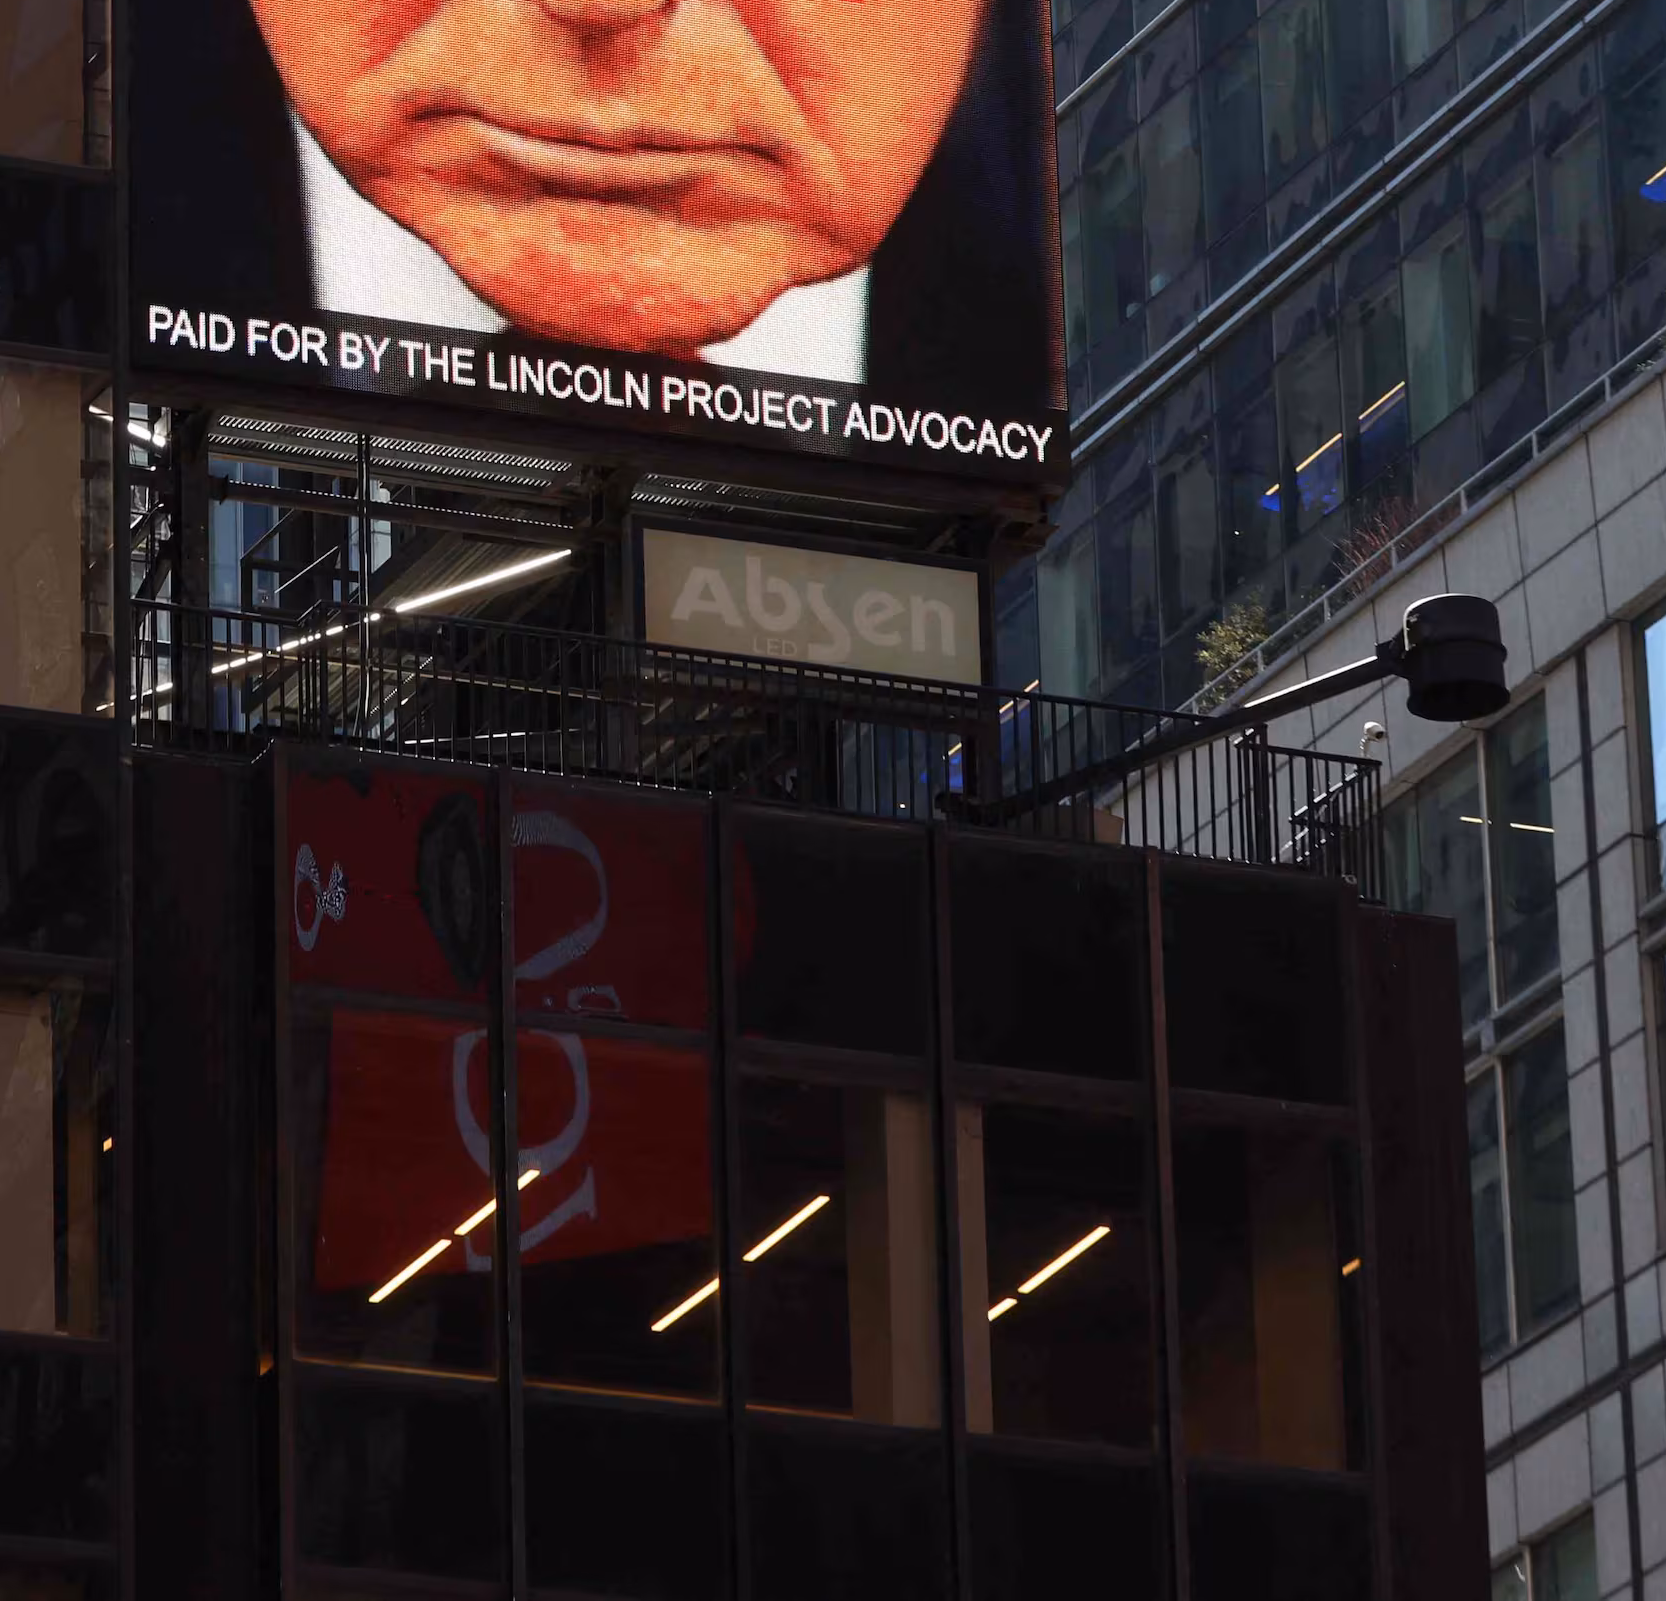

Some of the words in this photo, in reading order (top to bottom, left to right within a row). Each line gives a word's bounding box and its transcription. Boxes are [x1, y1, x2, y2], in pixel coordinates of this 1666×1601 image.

[148, 305, 235, 352] PAID
[246, 319, 328, 366] FOR
[340, 332, 391, 374] BY
[397, 339, 476, 387] THE
[486, 351, 649, 410] LINCOLN
[661, 375, 836, 435] PROJECT
[843, 402, 1053, 462] ADVOCACY
[670, 555, 956, 662] Absen
[752, 637, 799, 657] LED
